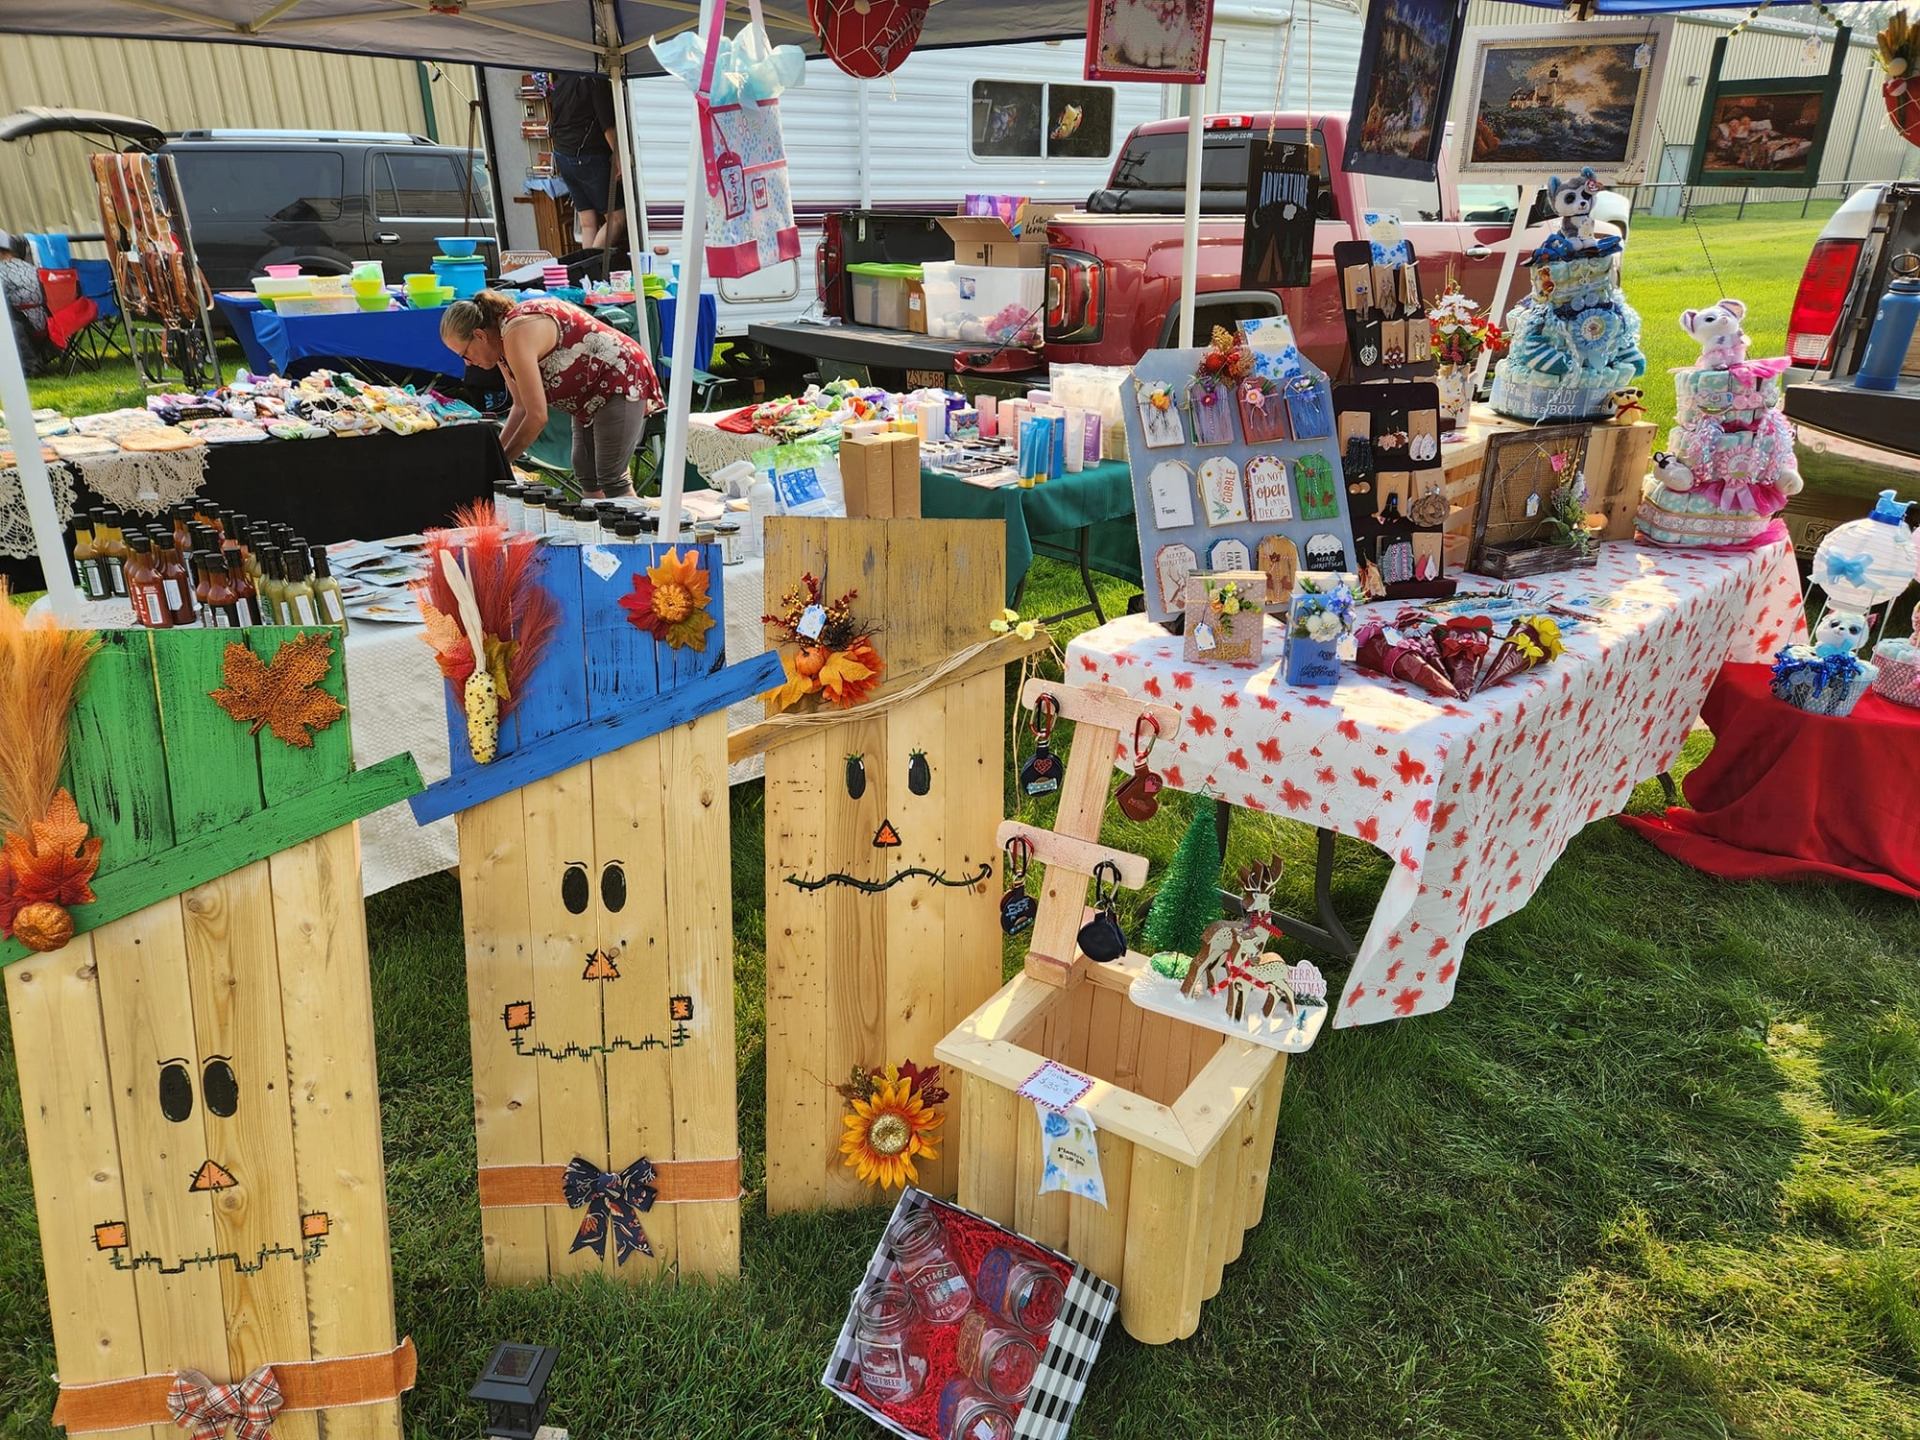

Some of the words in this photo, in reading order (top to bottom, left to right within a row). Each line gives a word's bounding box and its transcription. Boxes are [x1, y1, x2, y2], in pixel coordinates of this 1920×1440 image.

[1260, 171, 1309, 210] ADVENTURE
[1549, 404, 1576, 414] BOY
[1223, 469, 1236, 504] GOBBLE
[1267, 471, 1283, 482] NOT
[1257, 483, 1287, 507] open
[912, 1267, 949, 1289] VINTAGE
[935, 1304, 957, 1318] BEER
